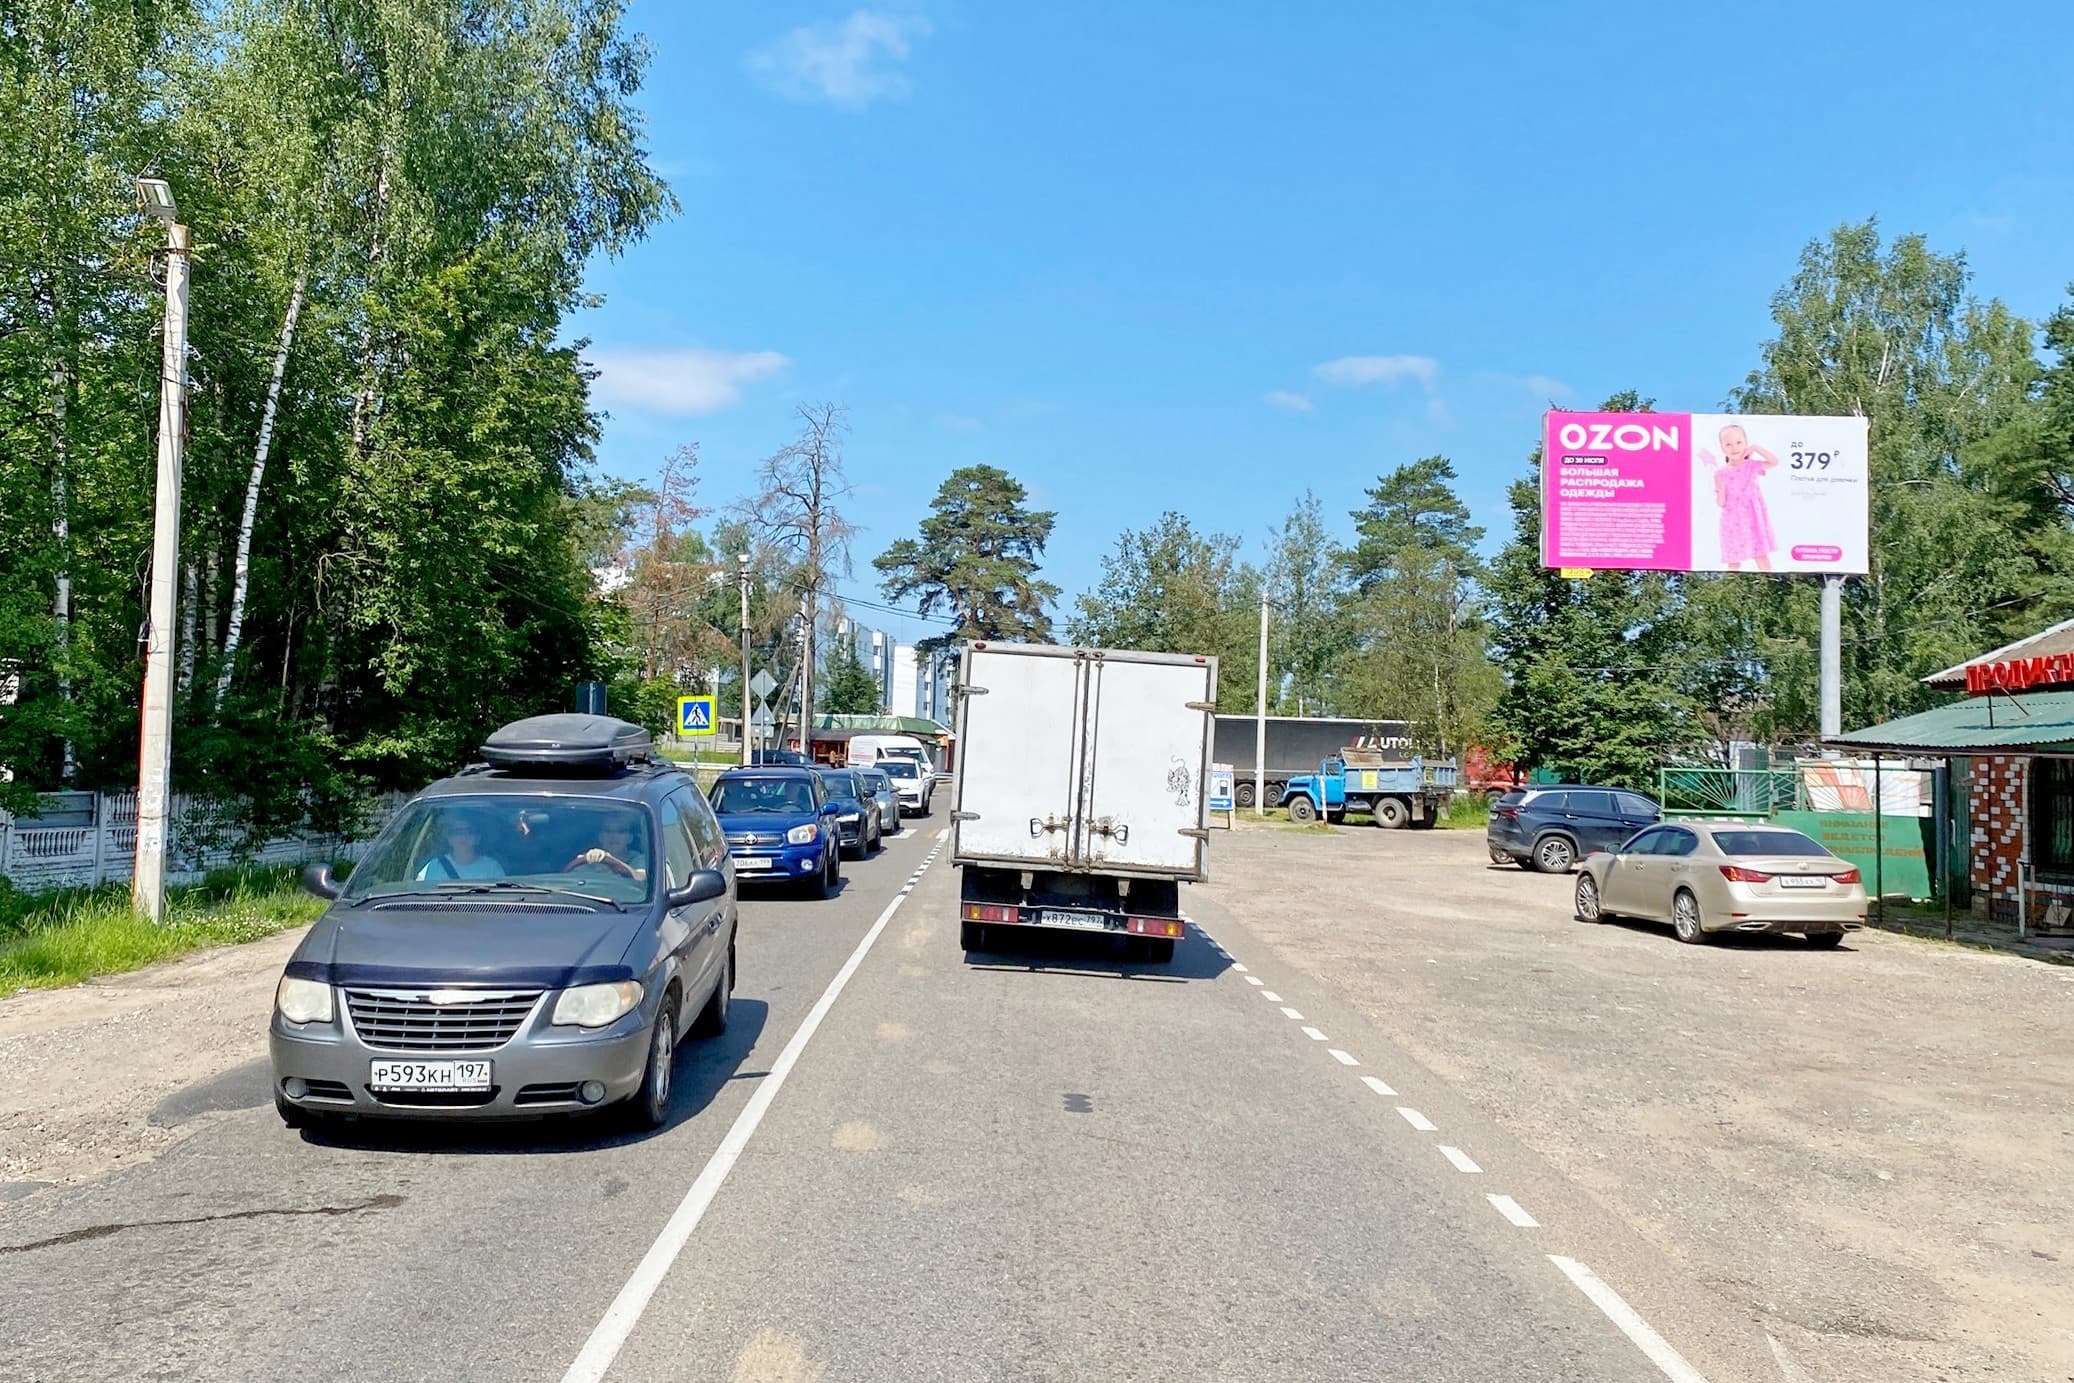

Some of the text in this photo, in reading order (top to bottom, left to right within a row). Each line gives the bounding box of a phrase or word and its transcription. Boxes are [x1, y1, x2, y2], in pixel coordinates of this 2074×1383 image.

[1560, 423, 1679, 451] OZON
[1791, 451, 1831, 470] 379
[1560, 467, 1619, 476] БОЛЬШАЯ
[1561, 478, 1645, 488] РАСПРОДАЖА
[1560, 488, 1615, 499] ОДЕЖДЫ
[457, 1064, 485, 1078] 197
